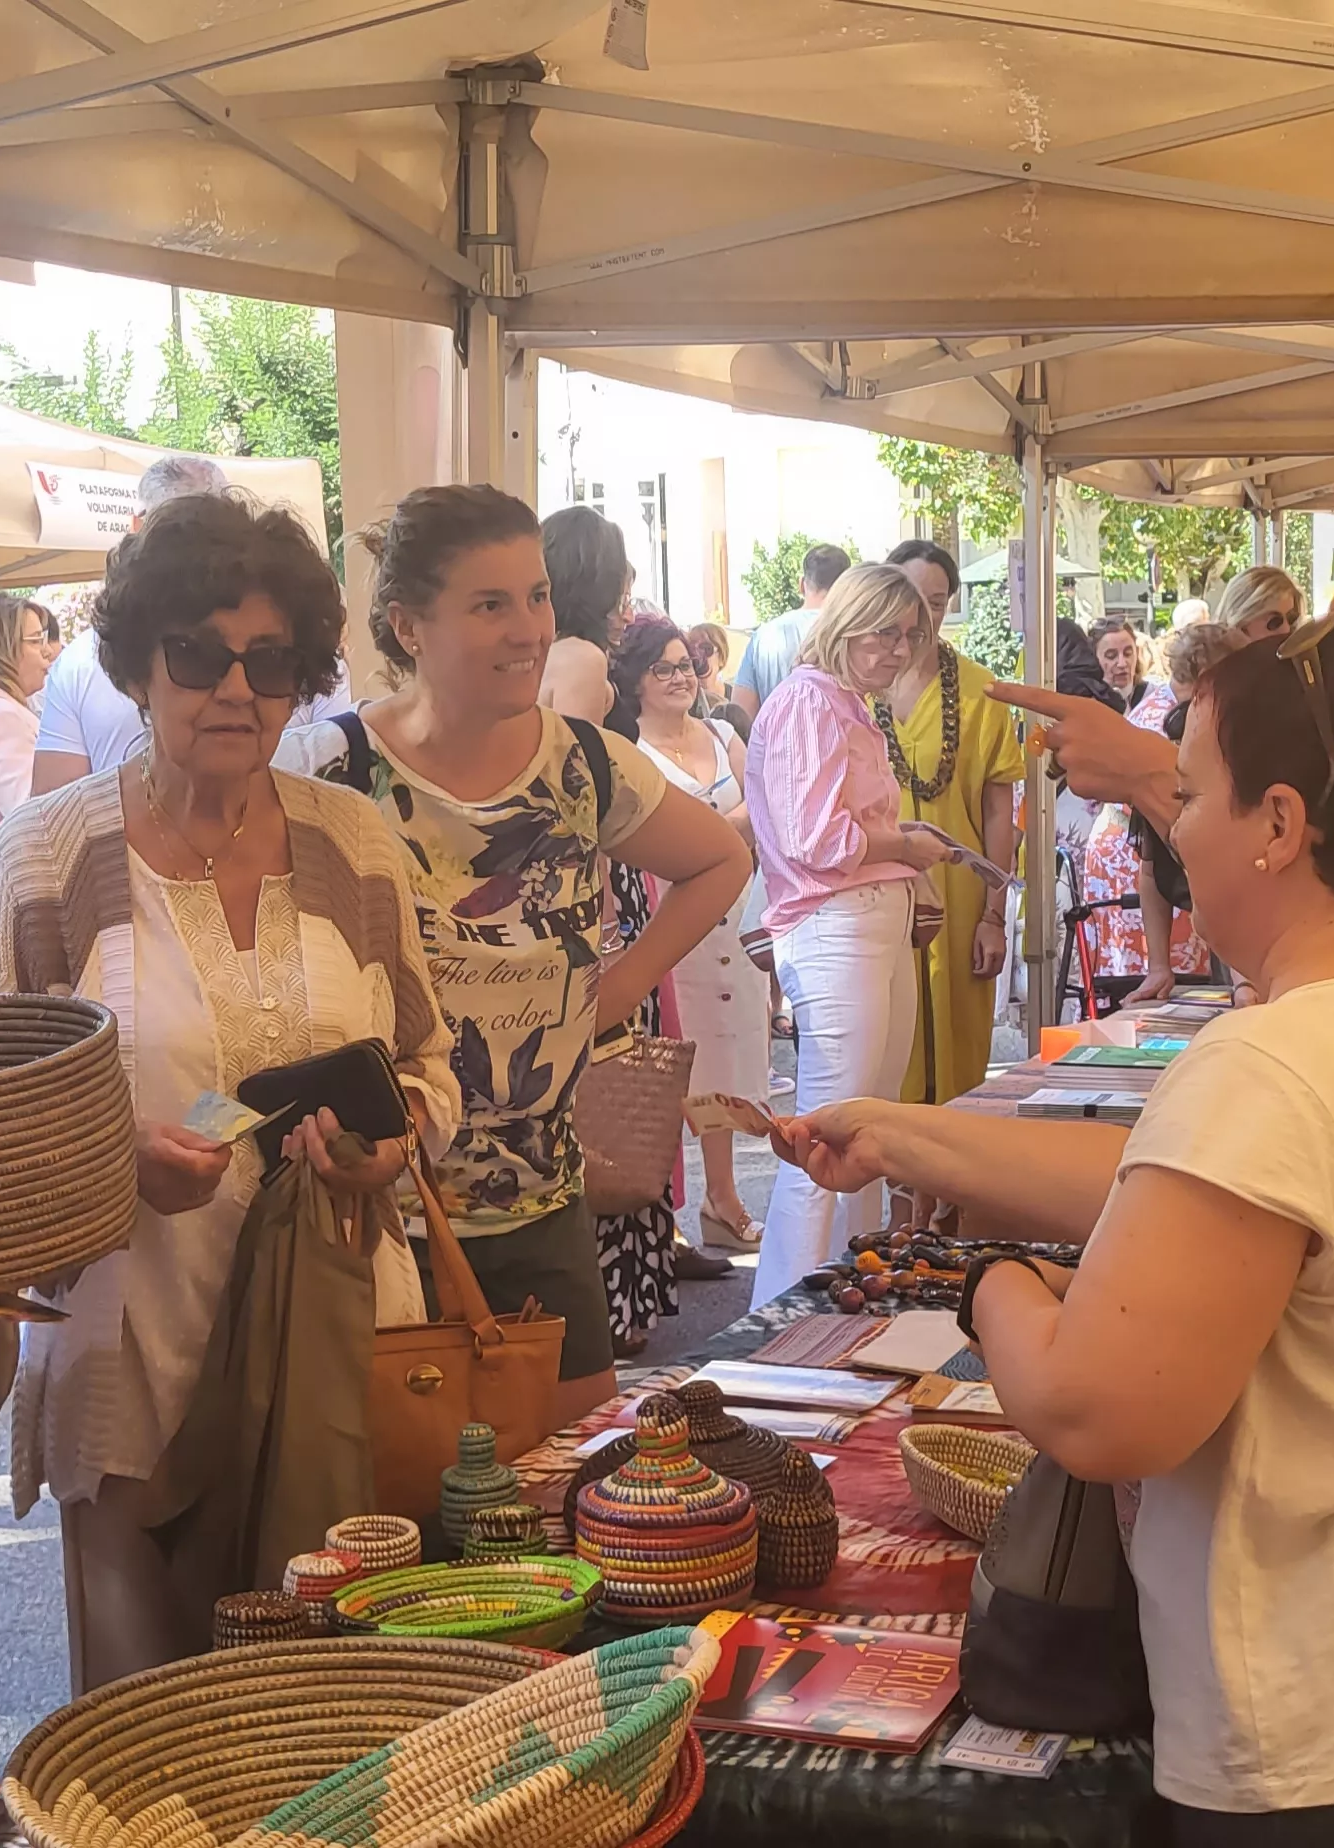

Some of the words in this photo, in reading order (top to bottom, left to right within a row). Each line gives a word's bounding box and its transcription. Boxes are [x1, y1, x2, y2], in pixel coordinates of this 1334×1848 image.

[78, 483, 132, 499] PLATAFORMA
[86, 501, 135, 516] VOLUNTARIA
[97, 520, 108, 532] DE
[429, 956, 480, 986] The
[484, 958, 534, 985] live
[537, 960, 562, 982] is
[491, 997, 556, 1031] color
[867, 1649, 957, 1709] AFRICA
